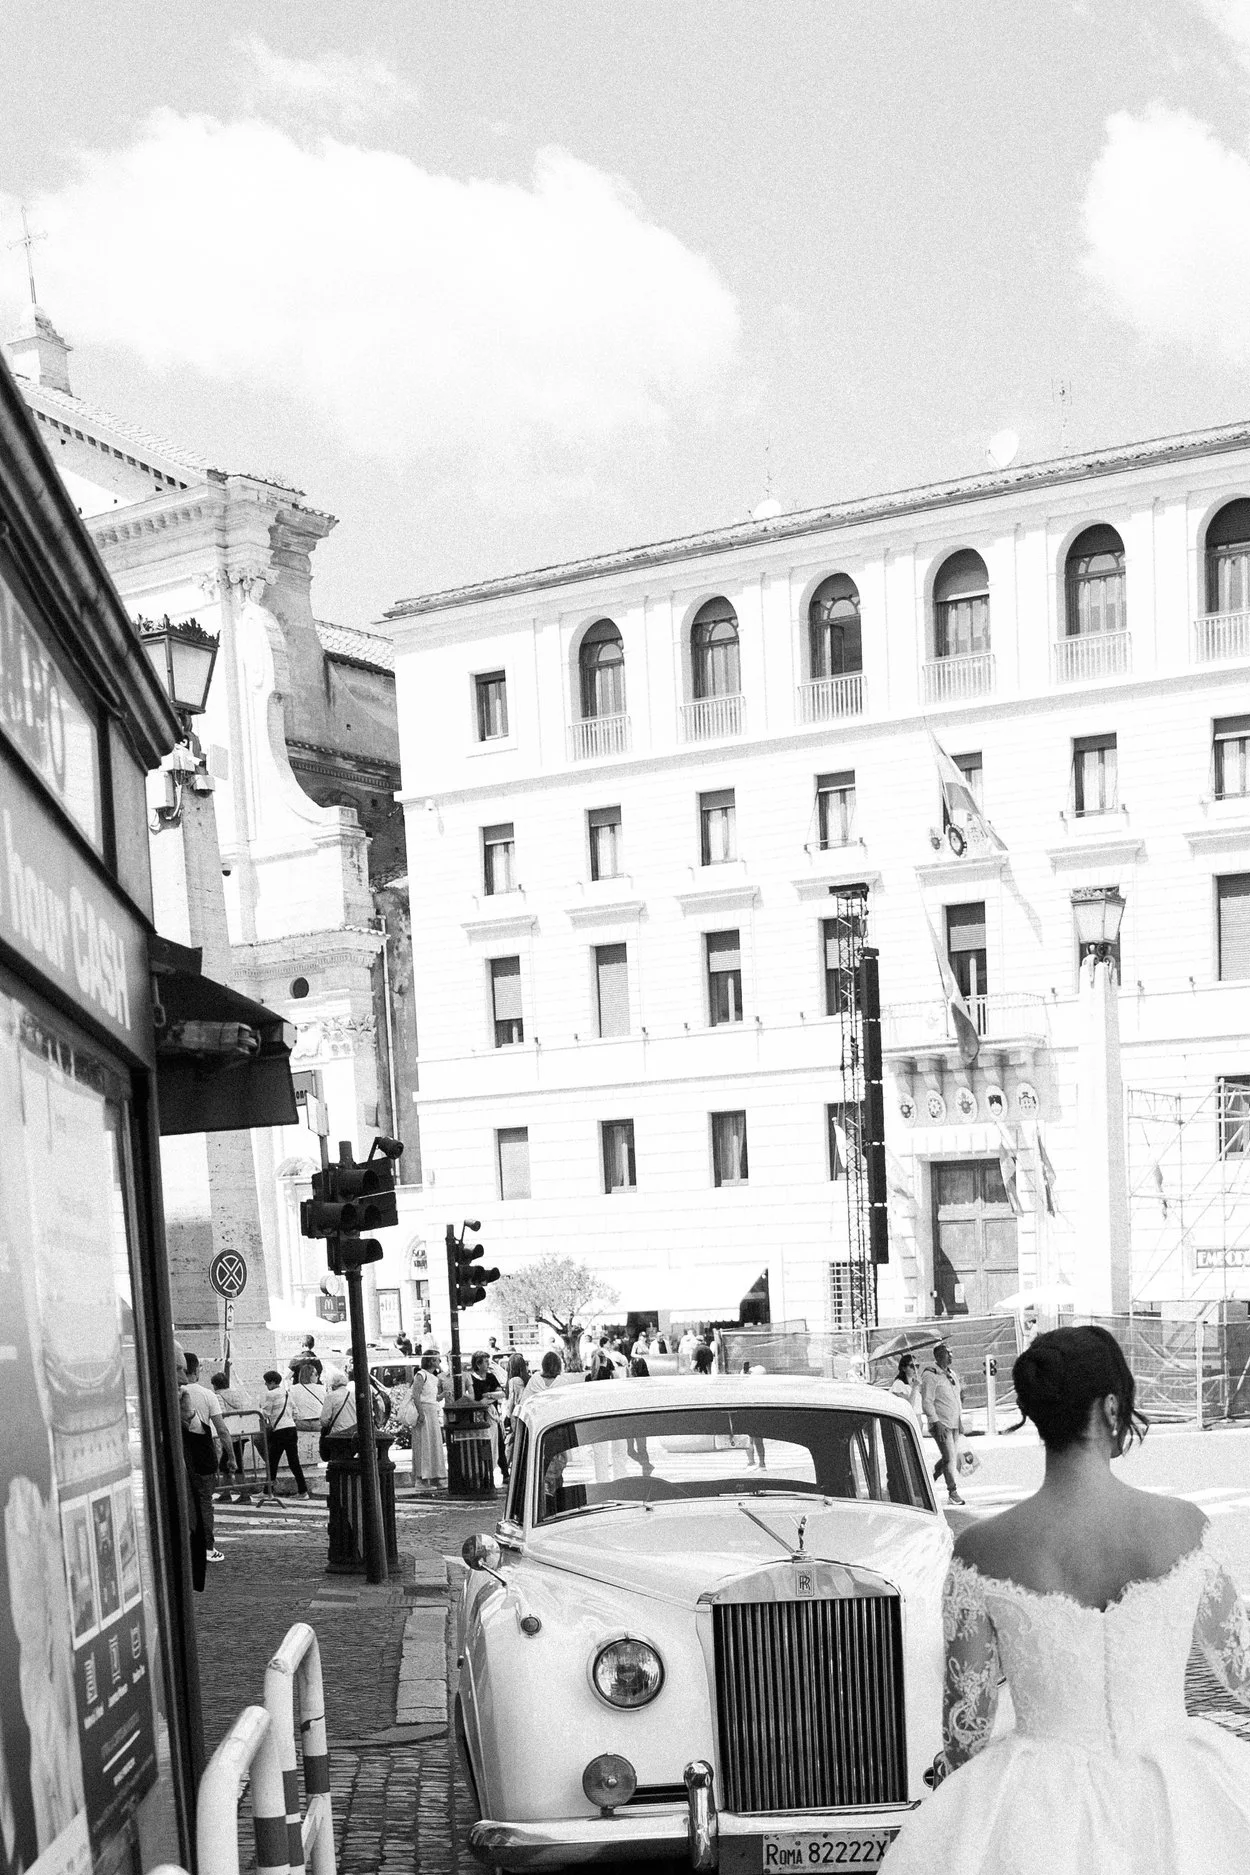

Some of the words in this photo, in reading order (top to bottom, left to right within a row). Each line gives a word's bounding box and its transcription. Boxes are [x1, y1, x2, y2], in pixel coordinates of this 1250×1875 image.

[4, 808, 69, 973] hour
[70, 886, 131, 1031] CASH
[808, 1840, 887, 1863] 82222X
